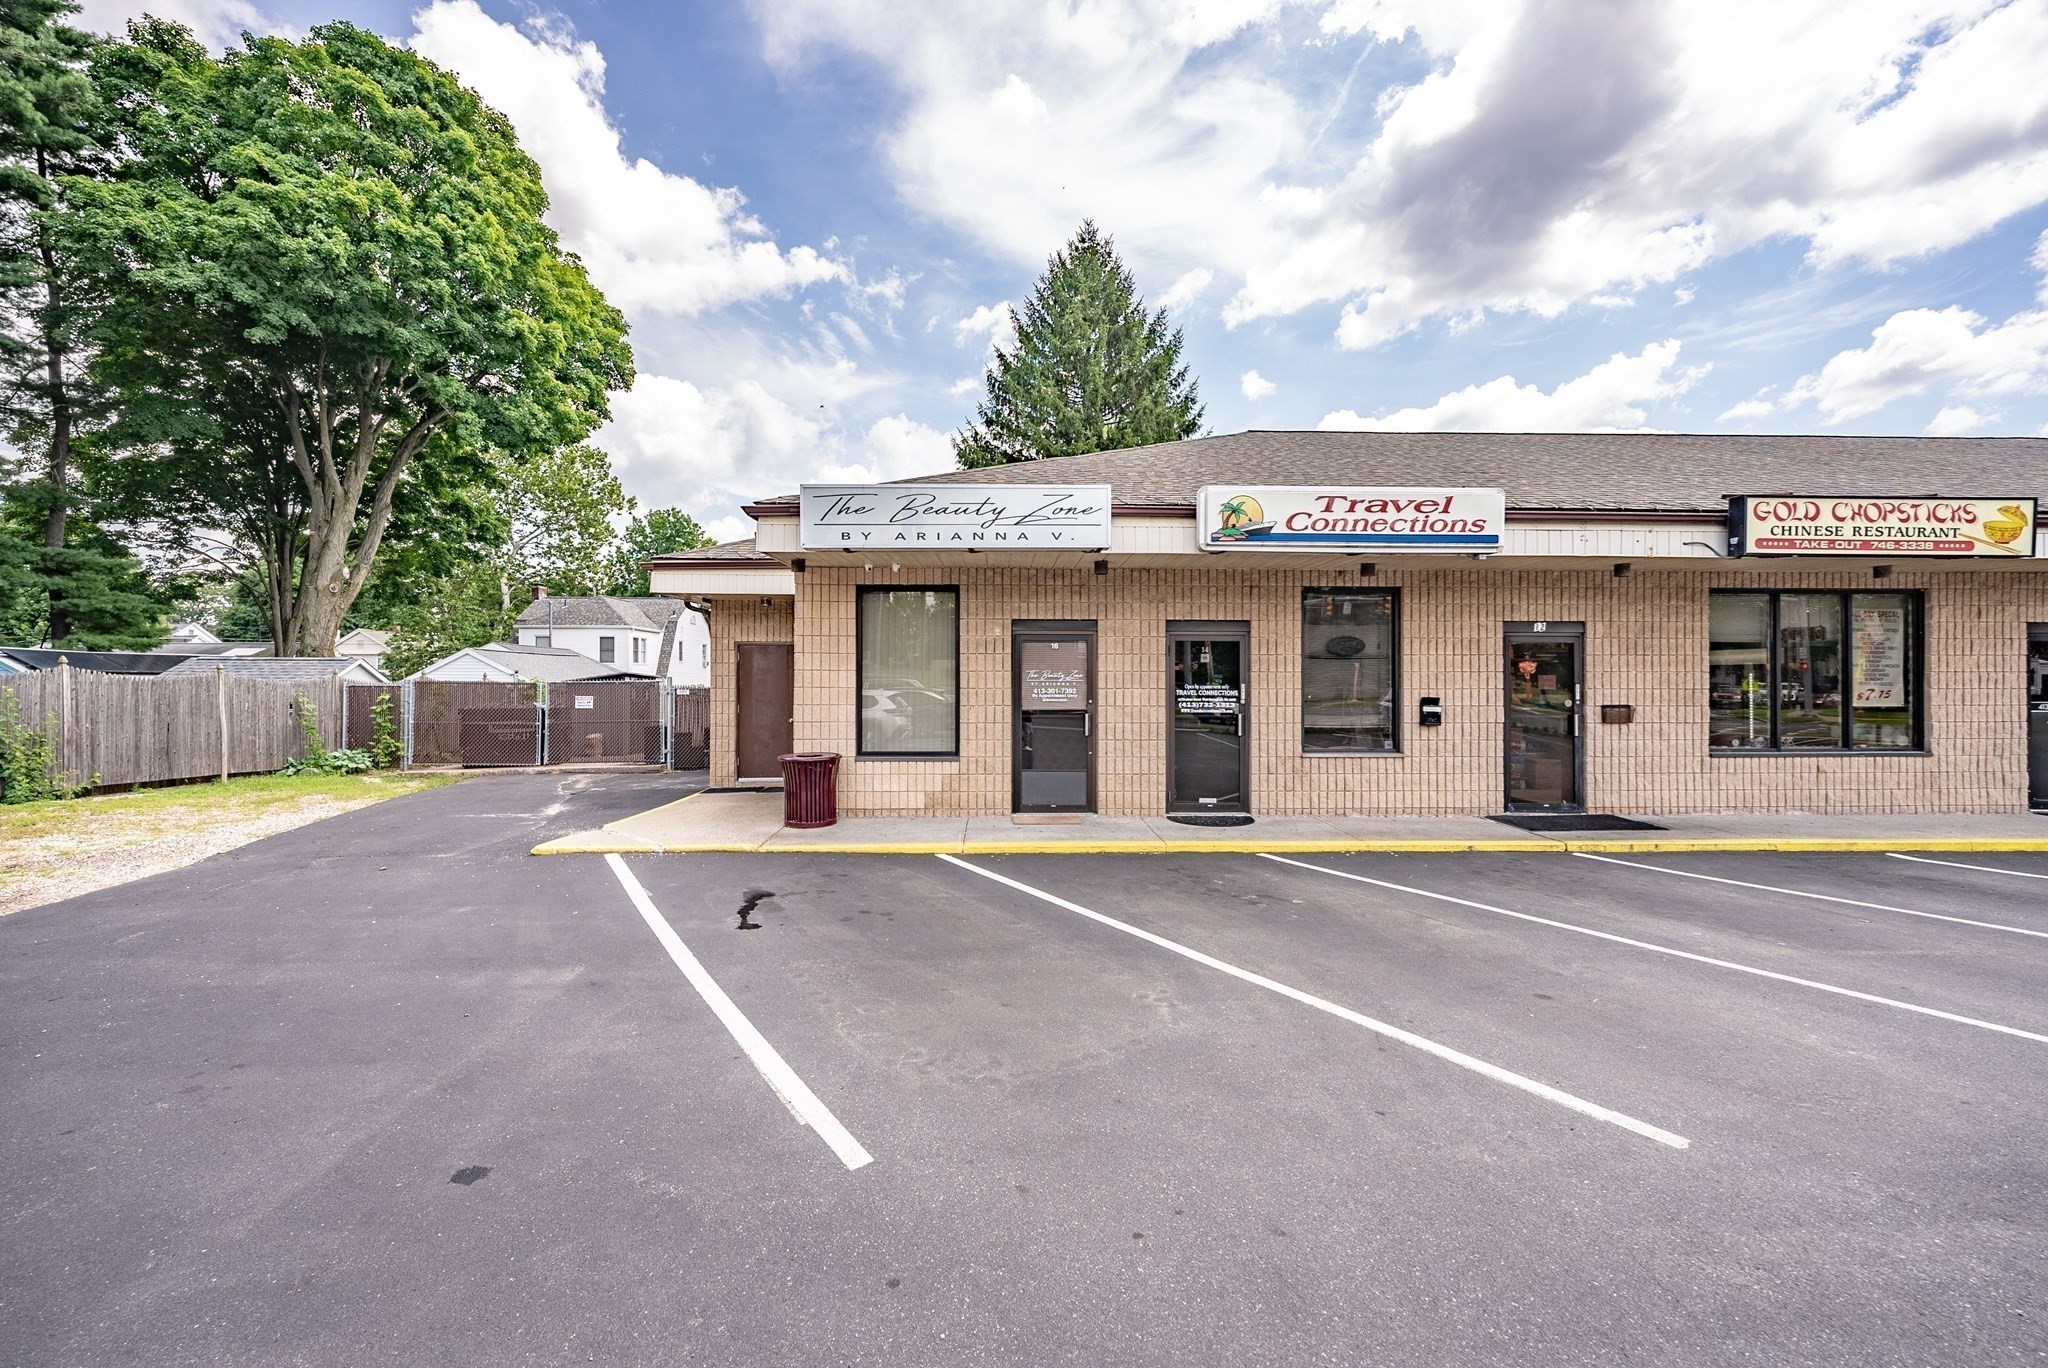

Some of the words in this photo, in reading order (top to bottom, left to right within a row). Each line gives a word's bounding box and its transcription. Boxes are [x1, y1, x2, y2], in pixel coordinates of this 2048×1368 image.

[813, 493, 878, 521] The
[889, 493, 1007, 529] Beauty
[1014, 494, 1102, 526] Zone
[1314, 495, 1454, 514] Travel
[1753, 501, 1821, 522] GOLD
[1831, 502, 1977, 524] CHOPSTICKS
[1285, 512, 1487, 533] Connections
[841, 532, 873, 541] BY
[894, 532, 1029, 541] ARIANNA
[1051, 532, 1075, 541] V.
[1770, 525, 1844, 537] CHINESE
[1852, 526, 1961, 538] RESTAURANT
[1793, 540, 1862, 549] TAKE-OUT
[1870, 541, 1934, 550] 746-3338
[1050, 642, 1059, 650] 16
